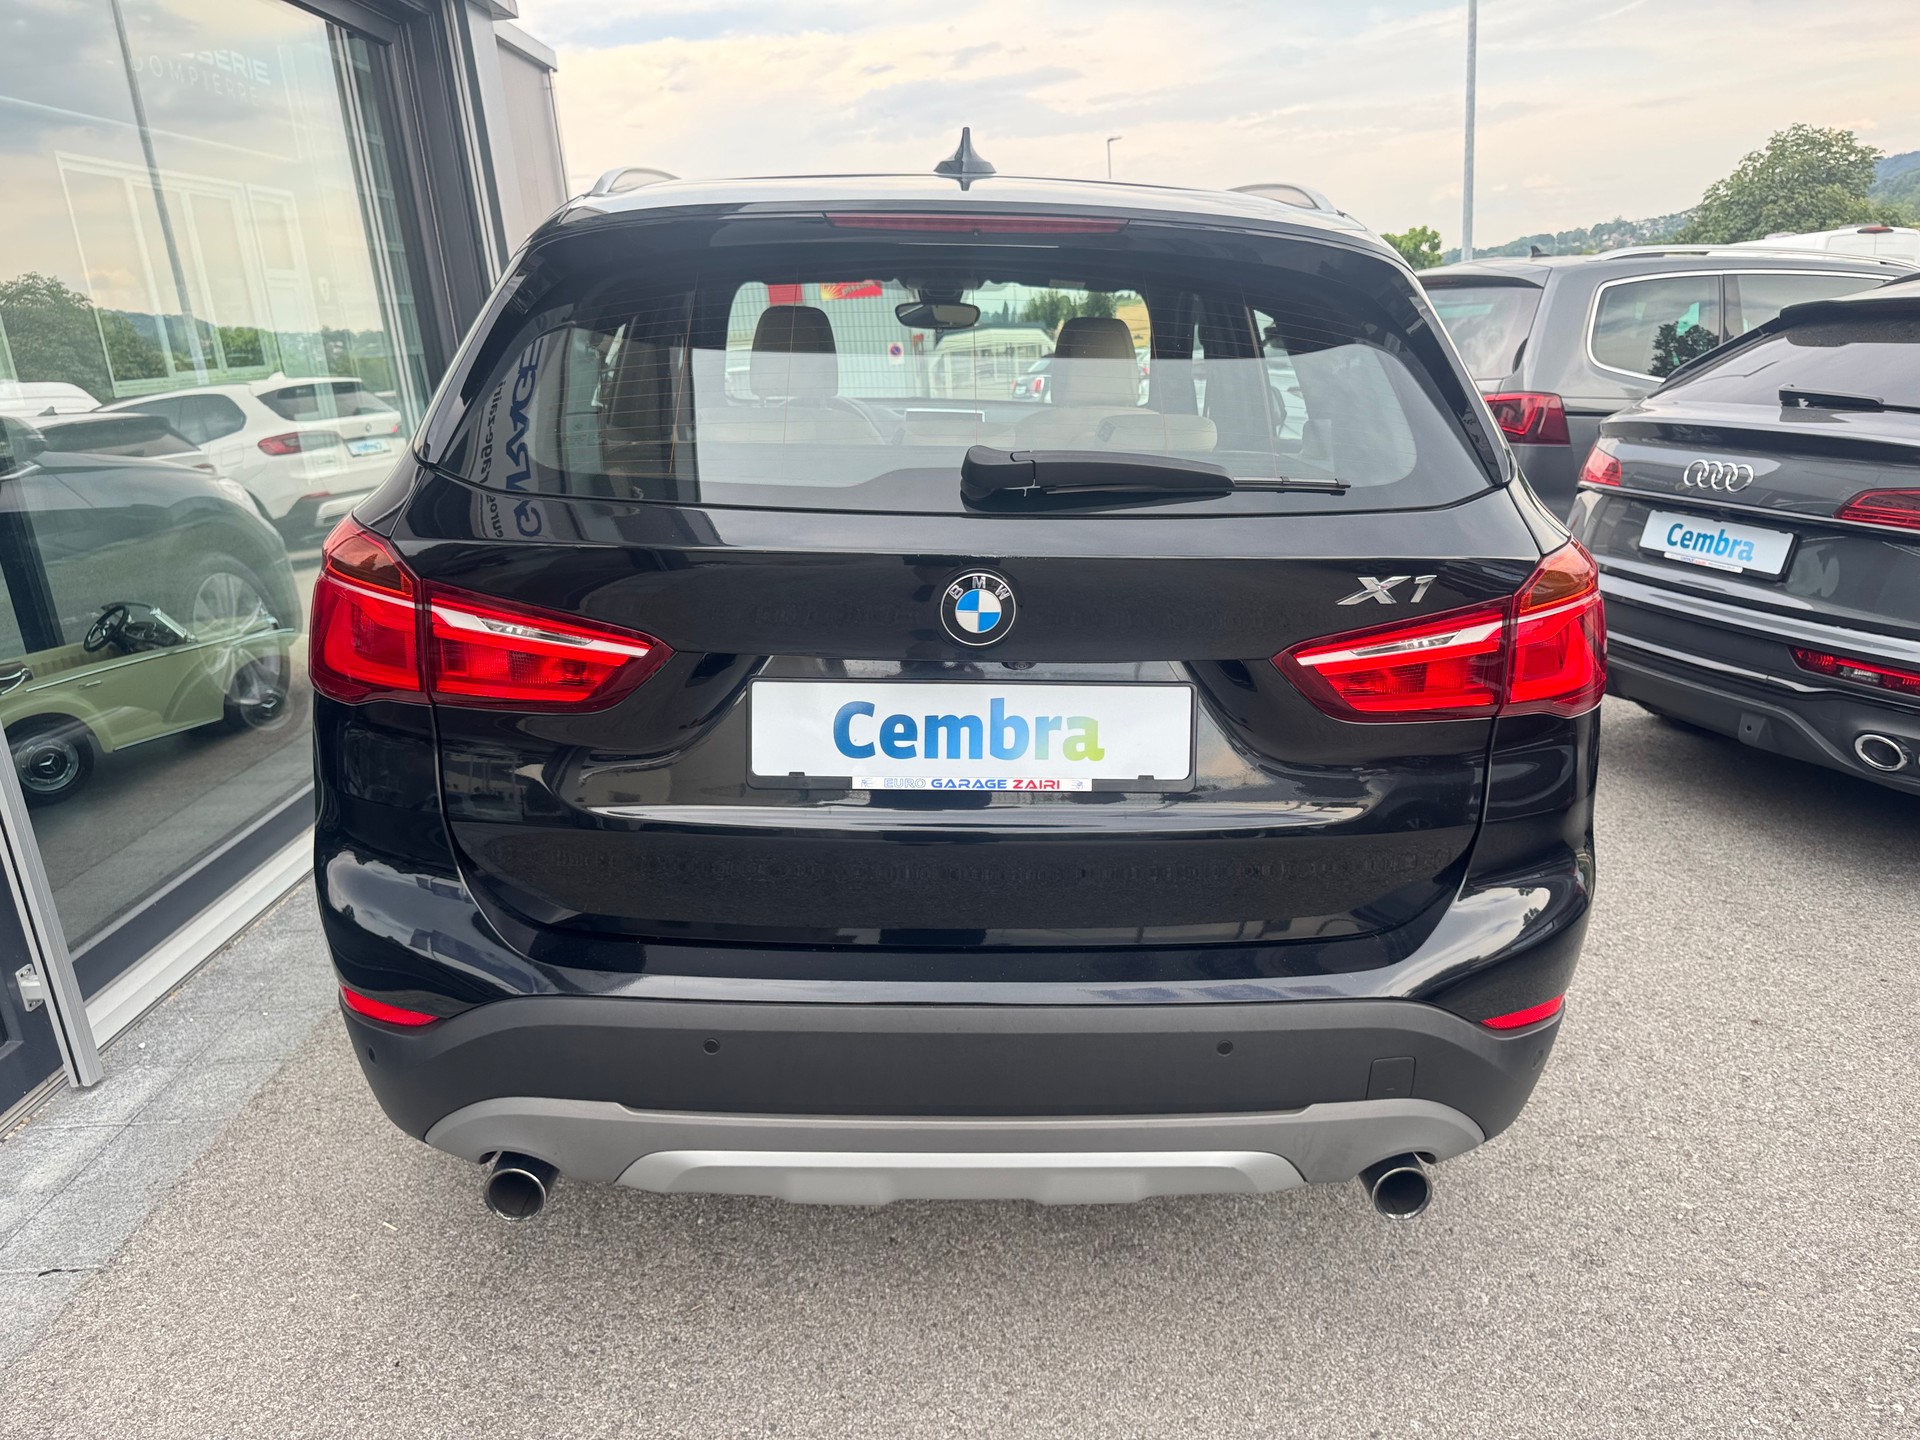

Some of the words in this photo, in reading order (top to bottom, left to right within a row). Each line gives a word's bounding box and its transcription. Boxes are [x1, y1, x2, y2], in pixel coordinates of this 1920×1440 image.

[1666, 522, 1755, 562] Cembra
[949, 576, 1010, 600] BMW
[1335, 574, 1438, 605] X1
[833, 697, 1105, 762] Cembra
[883, 777, 927, 789] EURO
[930, 778, 1008, 790] GARAGE
[1012, 779, 1061, 790] ZAIRI
